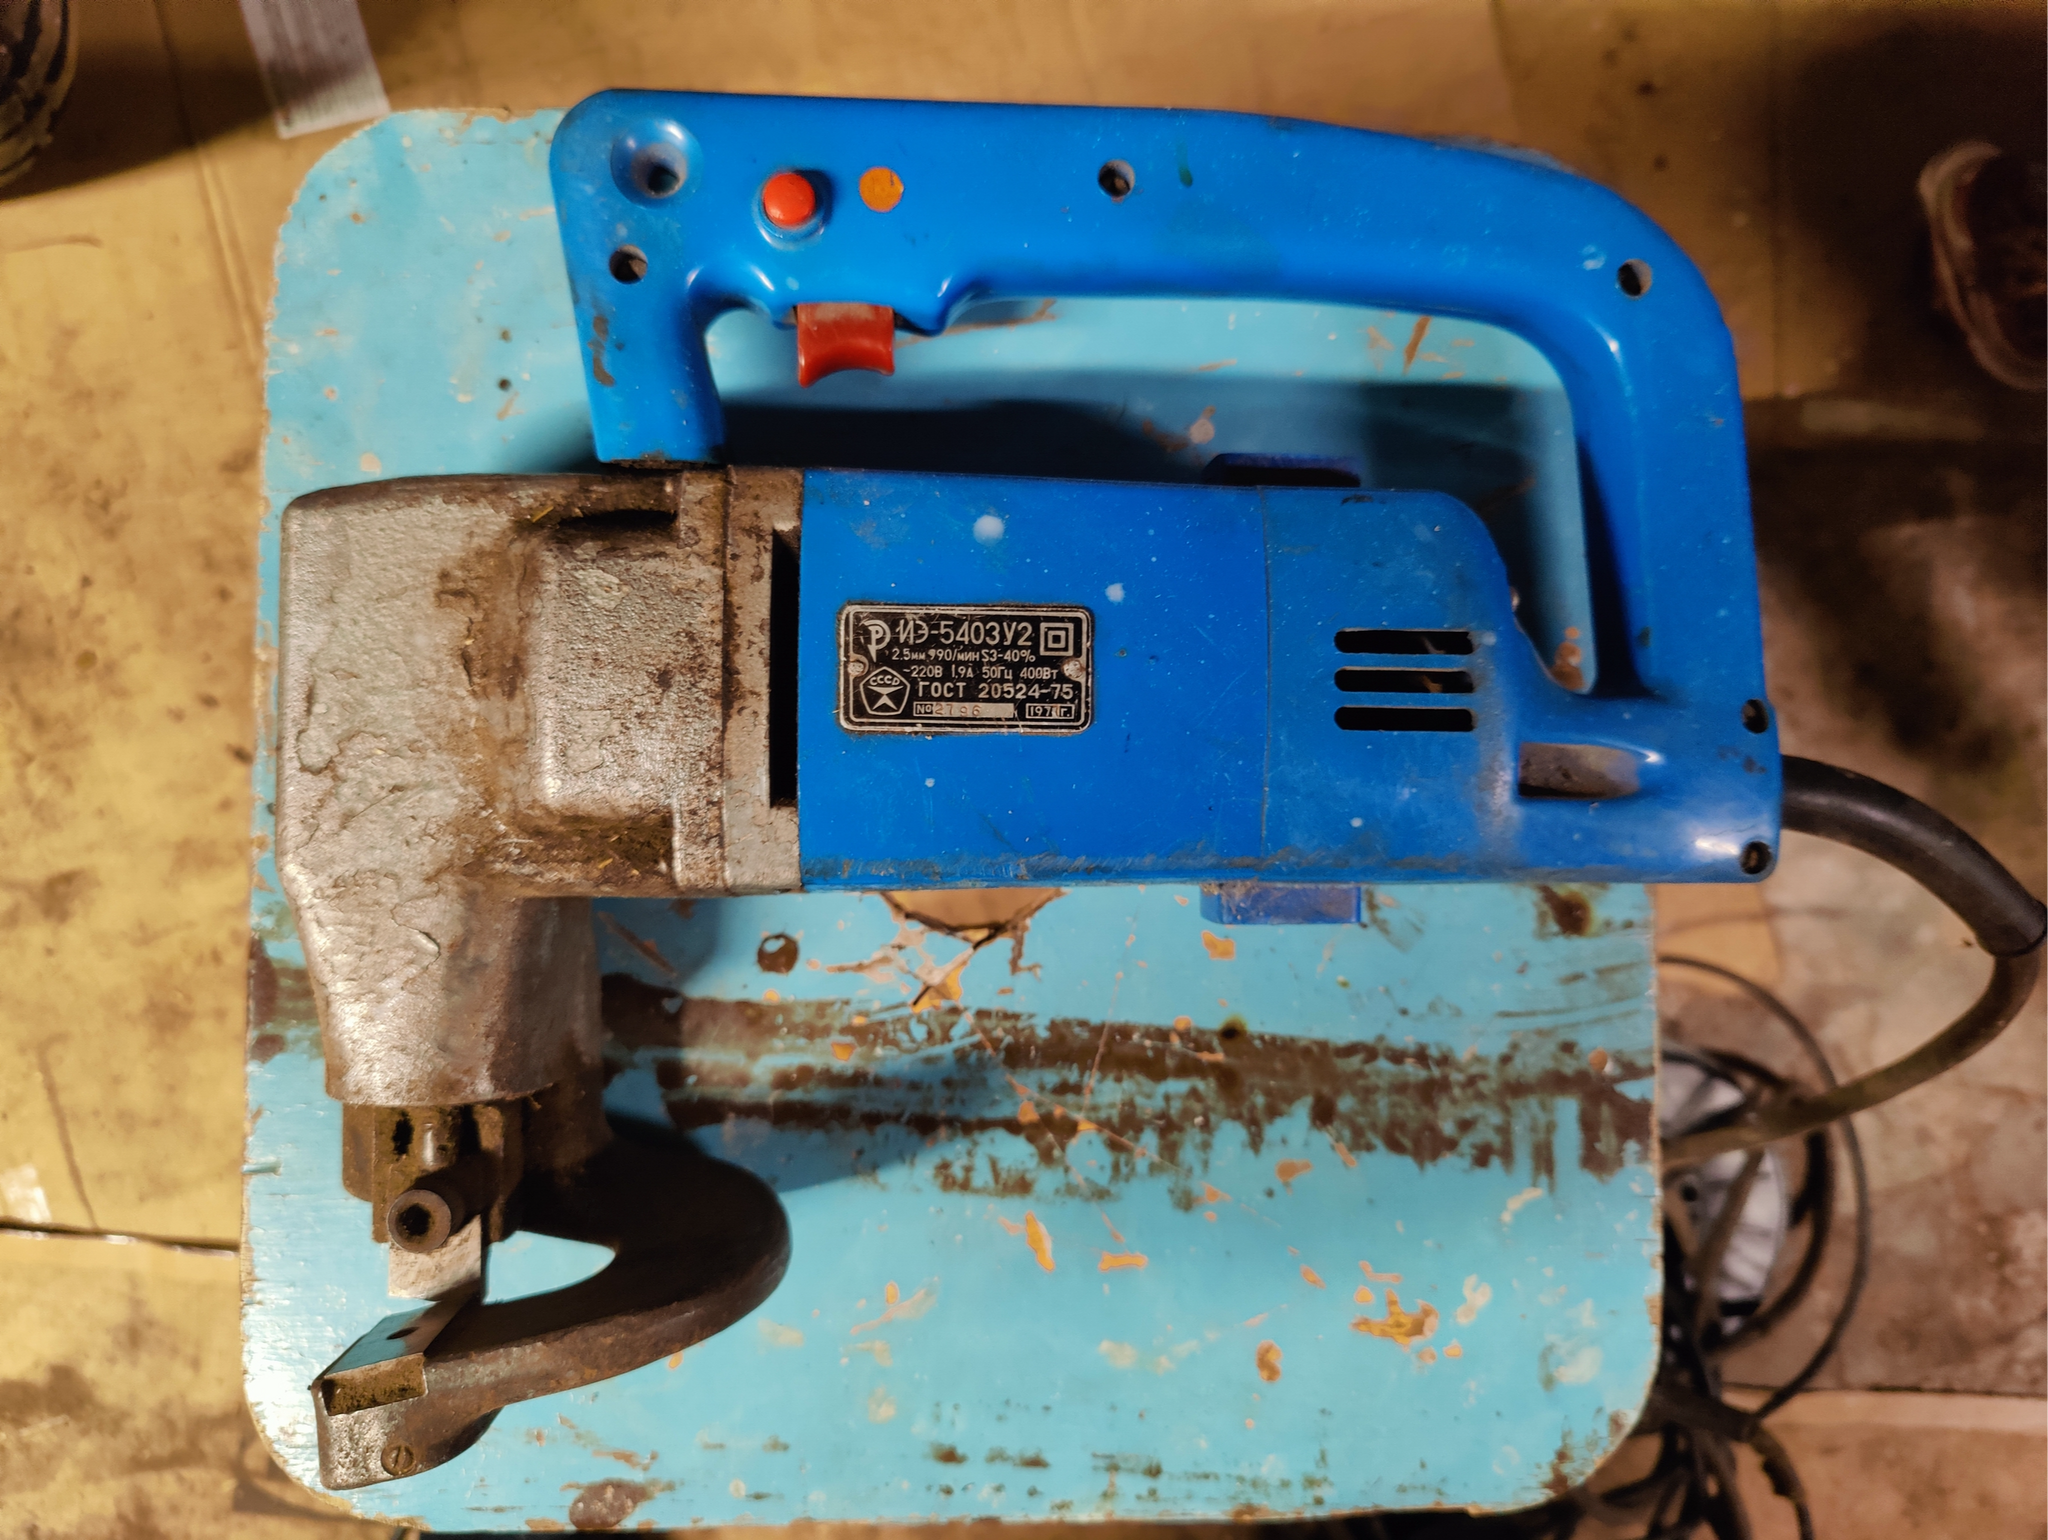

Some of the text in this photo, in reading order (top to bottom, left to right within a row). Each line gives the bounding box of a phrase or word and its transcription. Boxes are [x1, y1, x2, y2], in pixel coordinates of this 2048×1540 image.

[981, 649, 1036, 662] S3-40%
[982, 666, 1013, 679] 50Гц
[1020, 667, 1059, 679] 400Вт
[918, 682, 1074, 700] ГОСТ 20524-75
